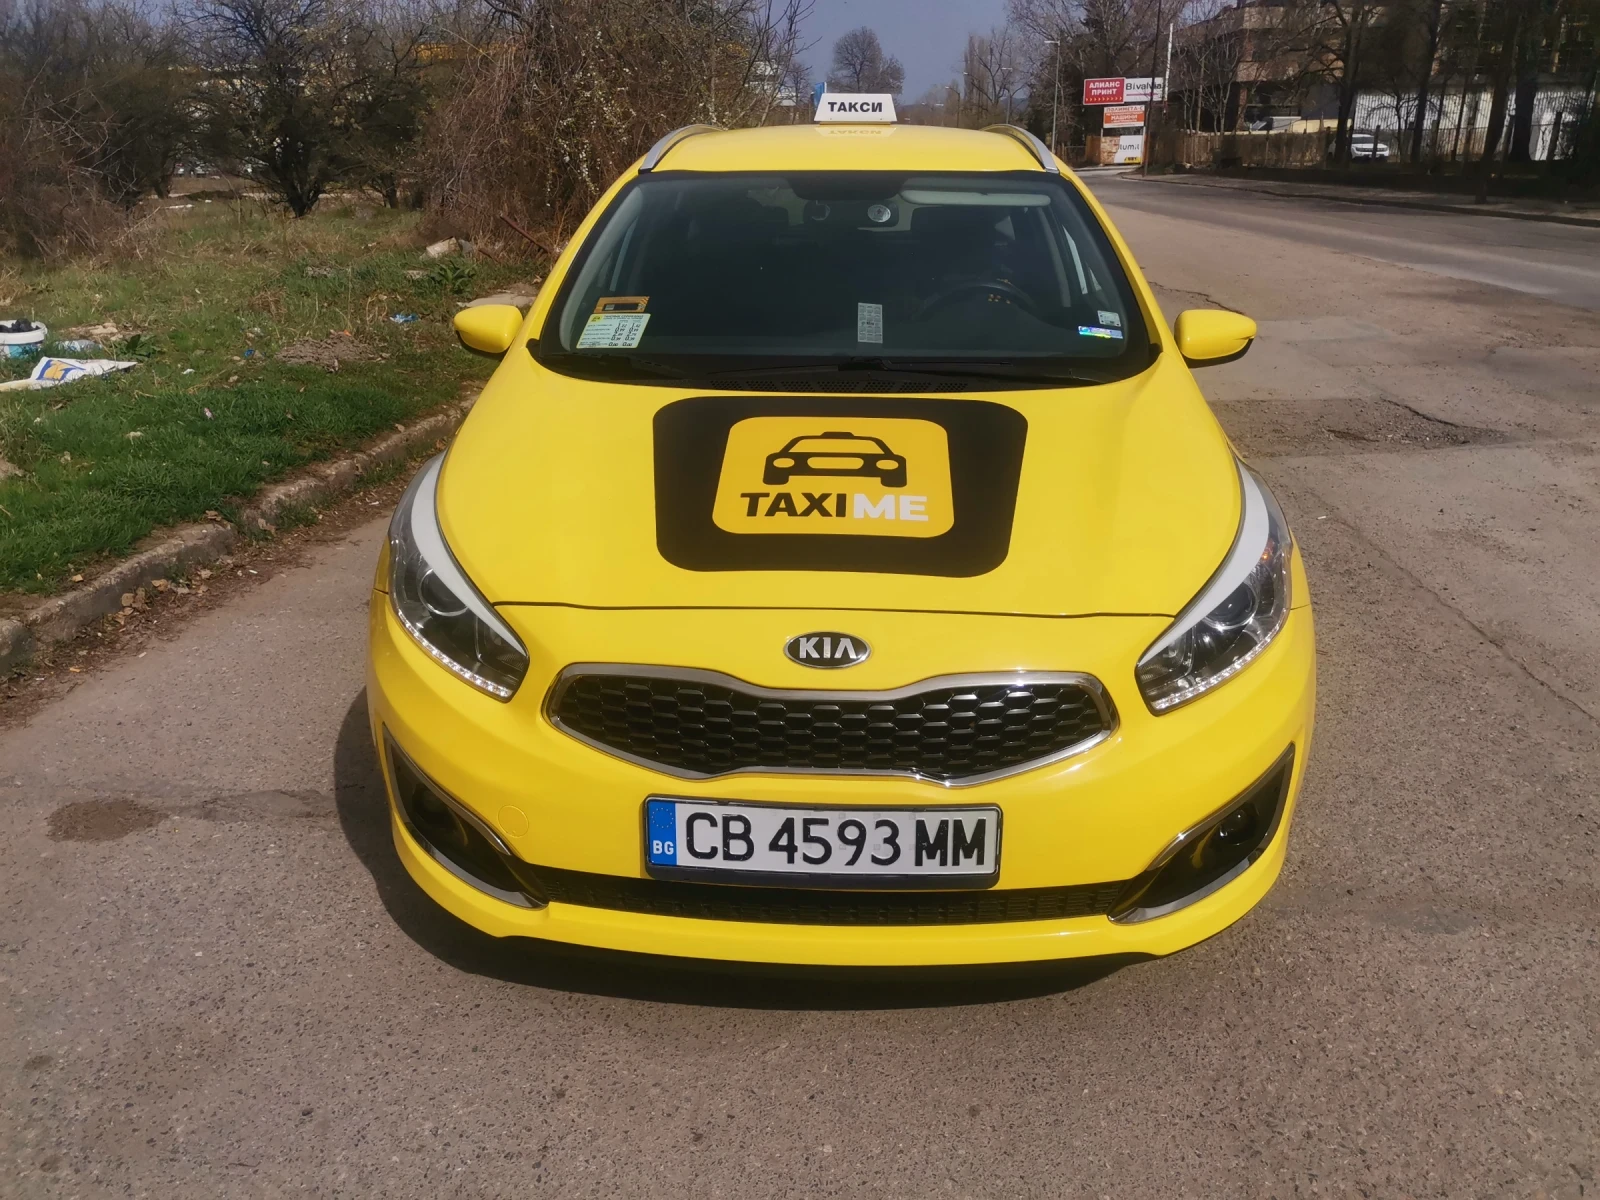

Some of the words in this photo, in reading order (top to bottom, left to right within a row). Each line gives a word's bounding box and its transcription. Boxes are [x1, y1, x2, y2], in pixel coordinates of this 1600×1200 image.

[828, 102, 883, 112] ТАКСИ
[799, 637, 857, 659] KIA
[653, 840, 674, 855] BG
[768, 817, 902, 866] 4593
[914, 818, 987, 867] MM
